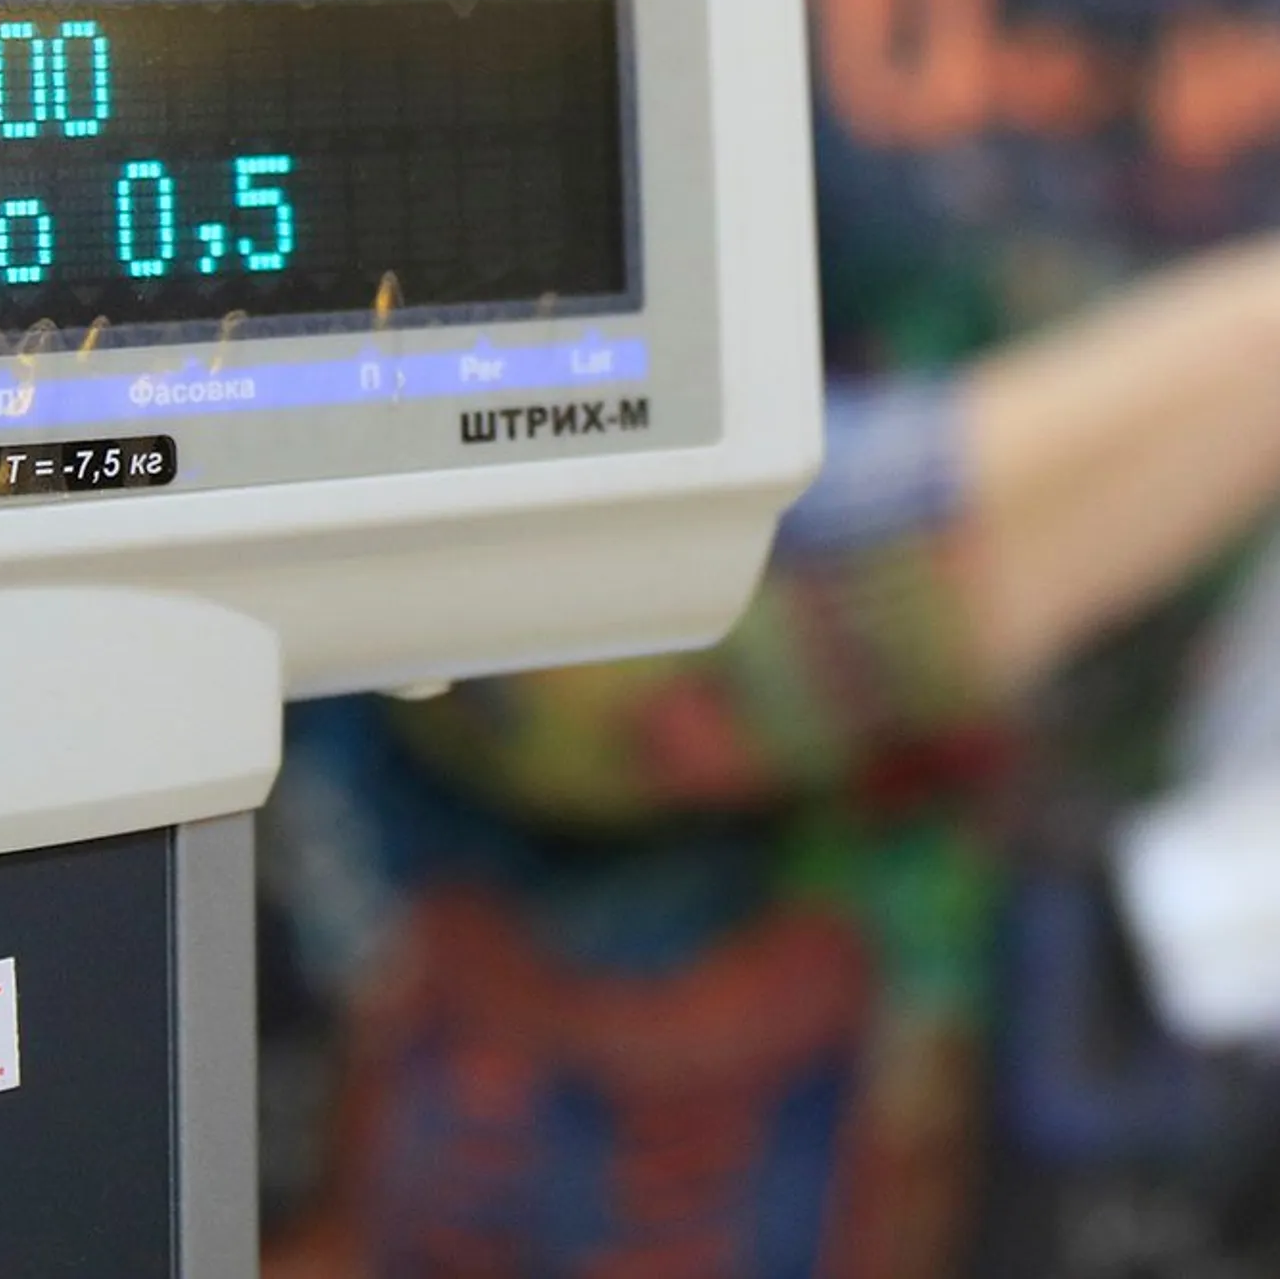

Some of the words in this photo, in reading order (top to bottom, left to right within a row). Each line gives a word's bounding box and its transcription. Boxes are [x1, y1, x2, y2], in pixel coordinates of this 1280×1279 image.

[117, 154, 296, 278] 0,5
[128, 373, 257, 408] Фасовка
[460, 398, 650, 445] ШТРИХ-М
[63, 448, 121, 485] -7,5
